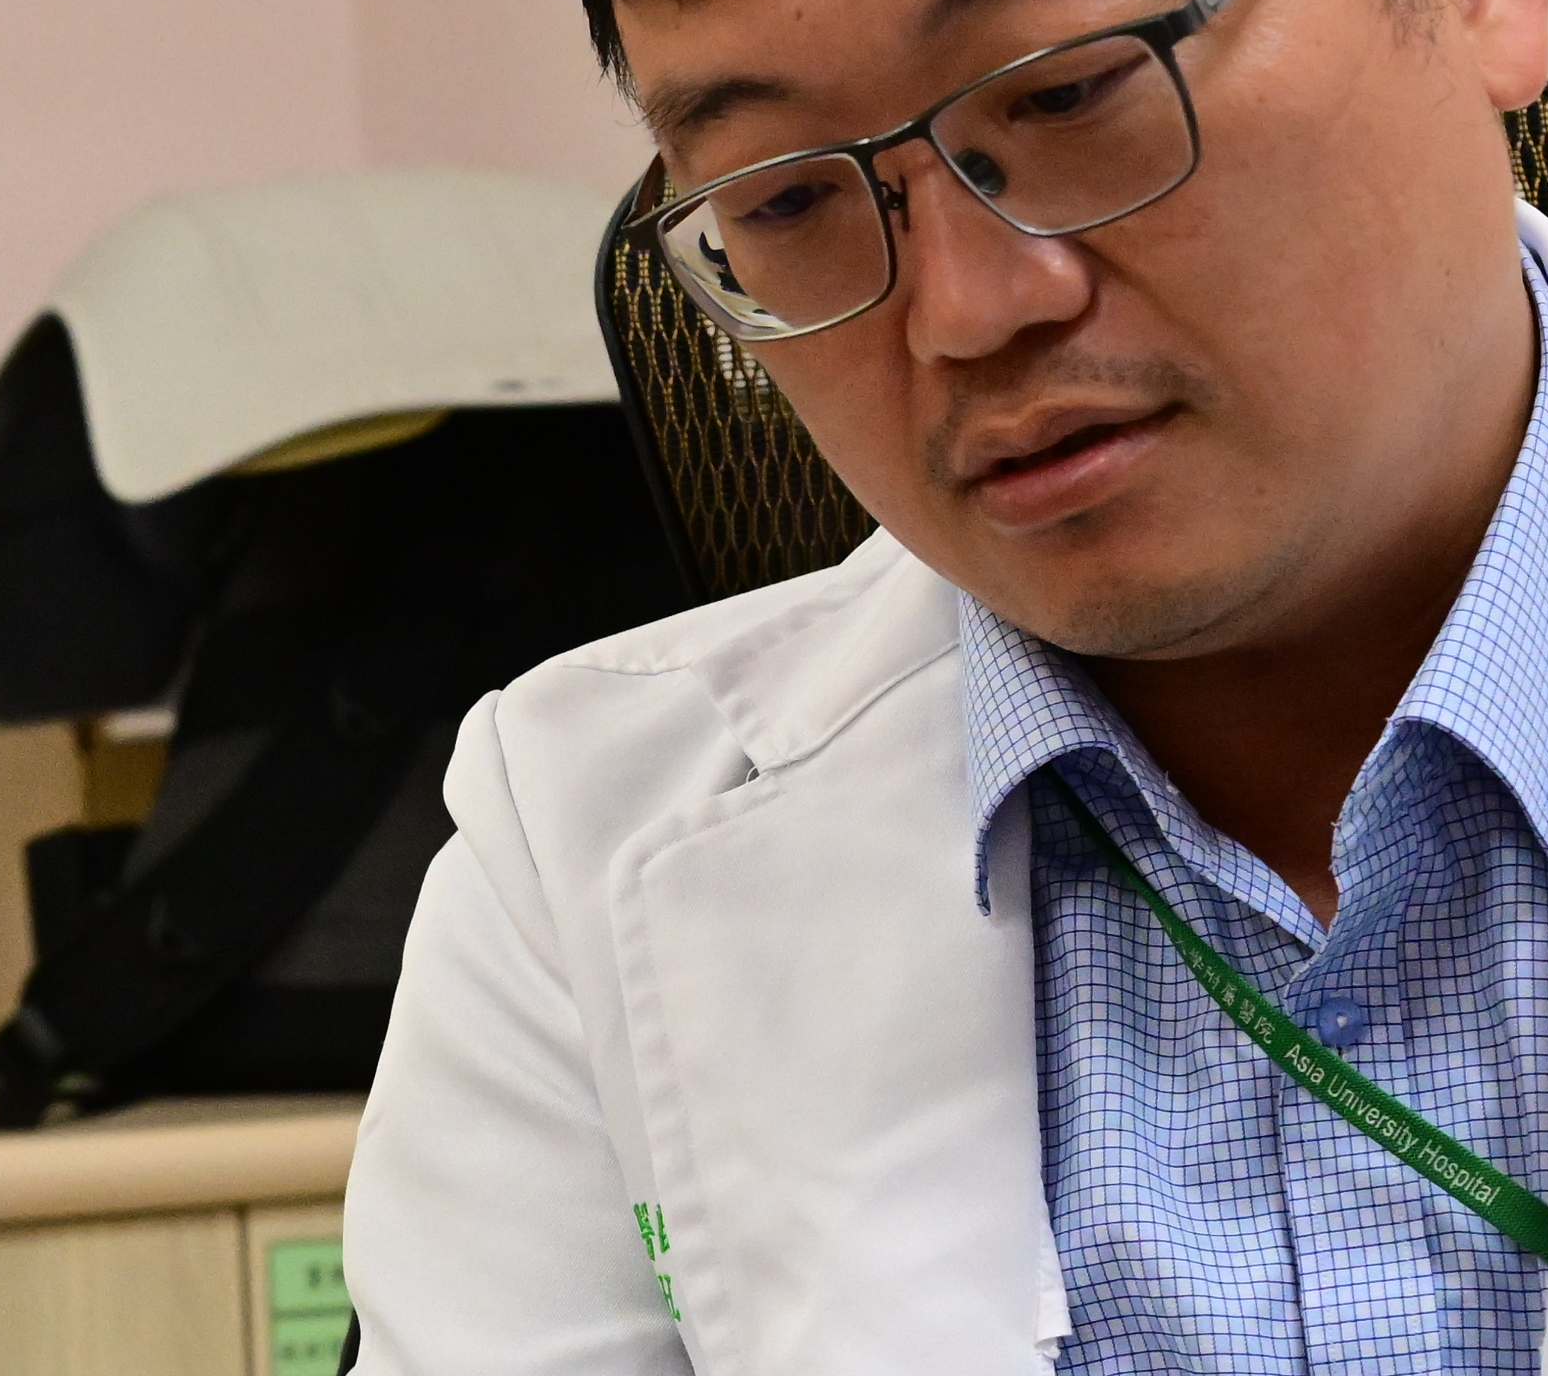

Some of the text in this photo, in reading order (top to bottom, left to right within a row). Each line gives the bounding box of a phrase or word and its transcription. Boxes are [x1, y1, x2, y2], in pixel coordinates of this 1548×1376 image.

[1168, 925, 1276, 1044] 大學附屬醫院
[1284, 1043, 1501, 1207] Asia University Hospital
